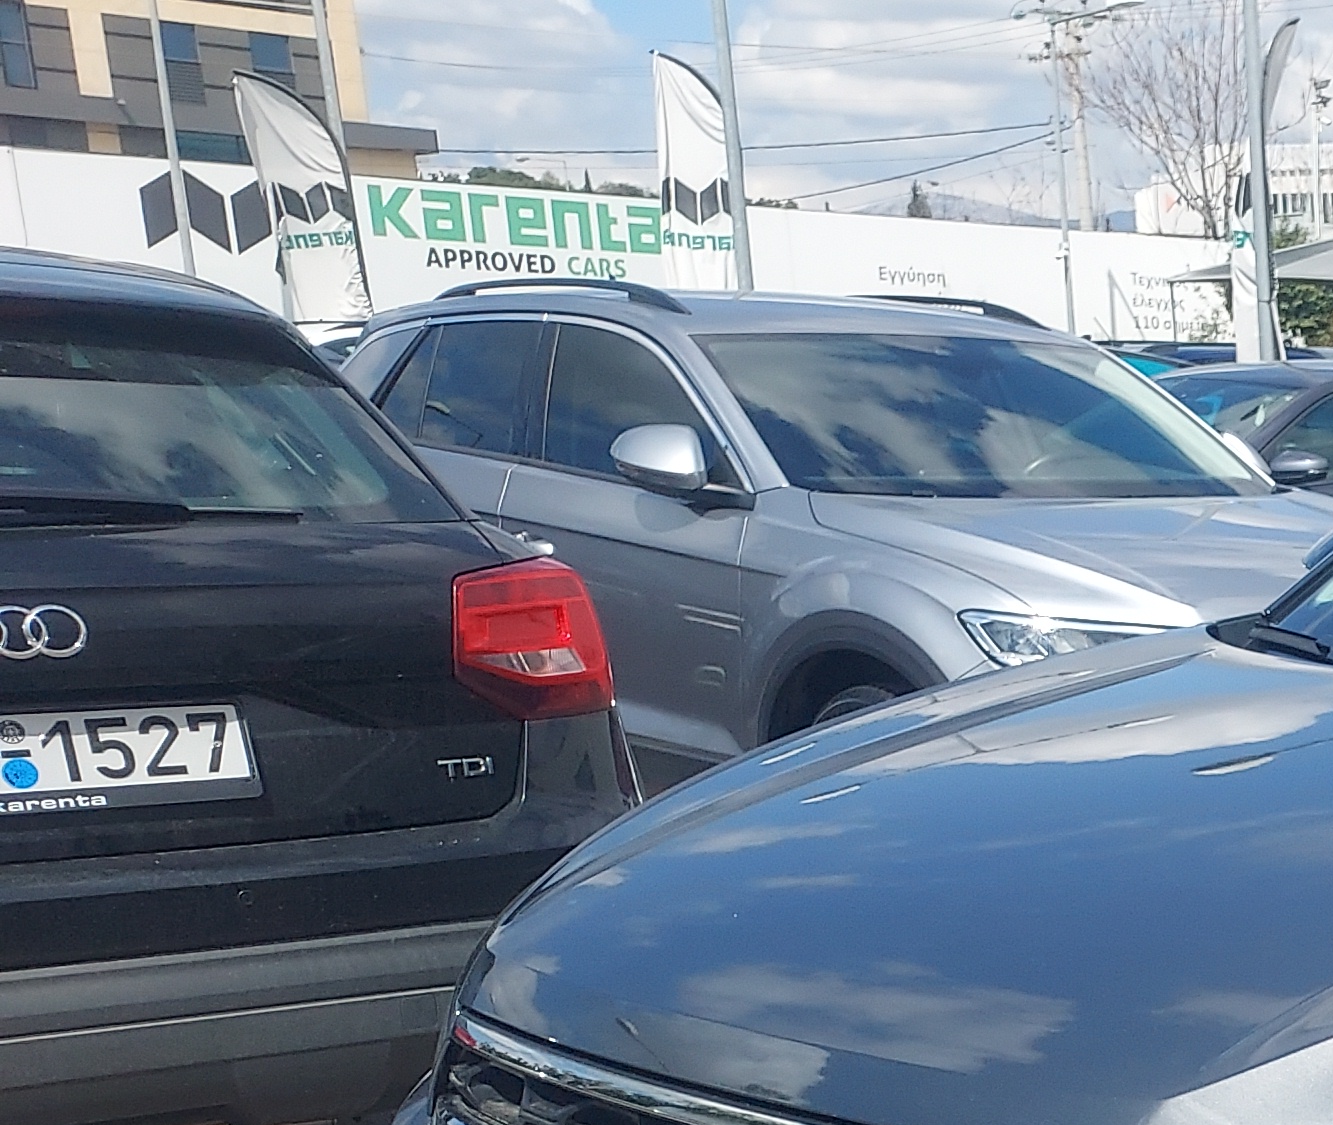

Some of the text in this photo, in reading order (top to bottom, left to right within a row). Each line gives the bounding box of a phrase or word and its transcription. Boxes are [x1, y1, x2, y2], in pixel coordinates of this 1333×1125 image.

[426, 247, 627, 279] APPROVED CARS
[878, 265, 947, 289] Εγγύηση
[436, 756, 495, 778] TDI
